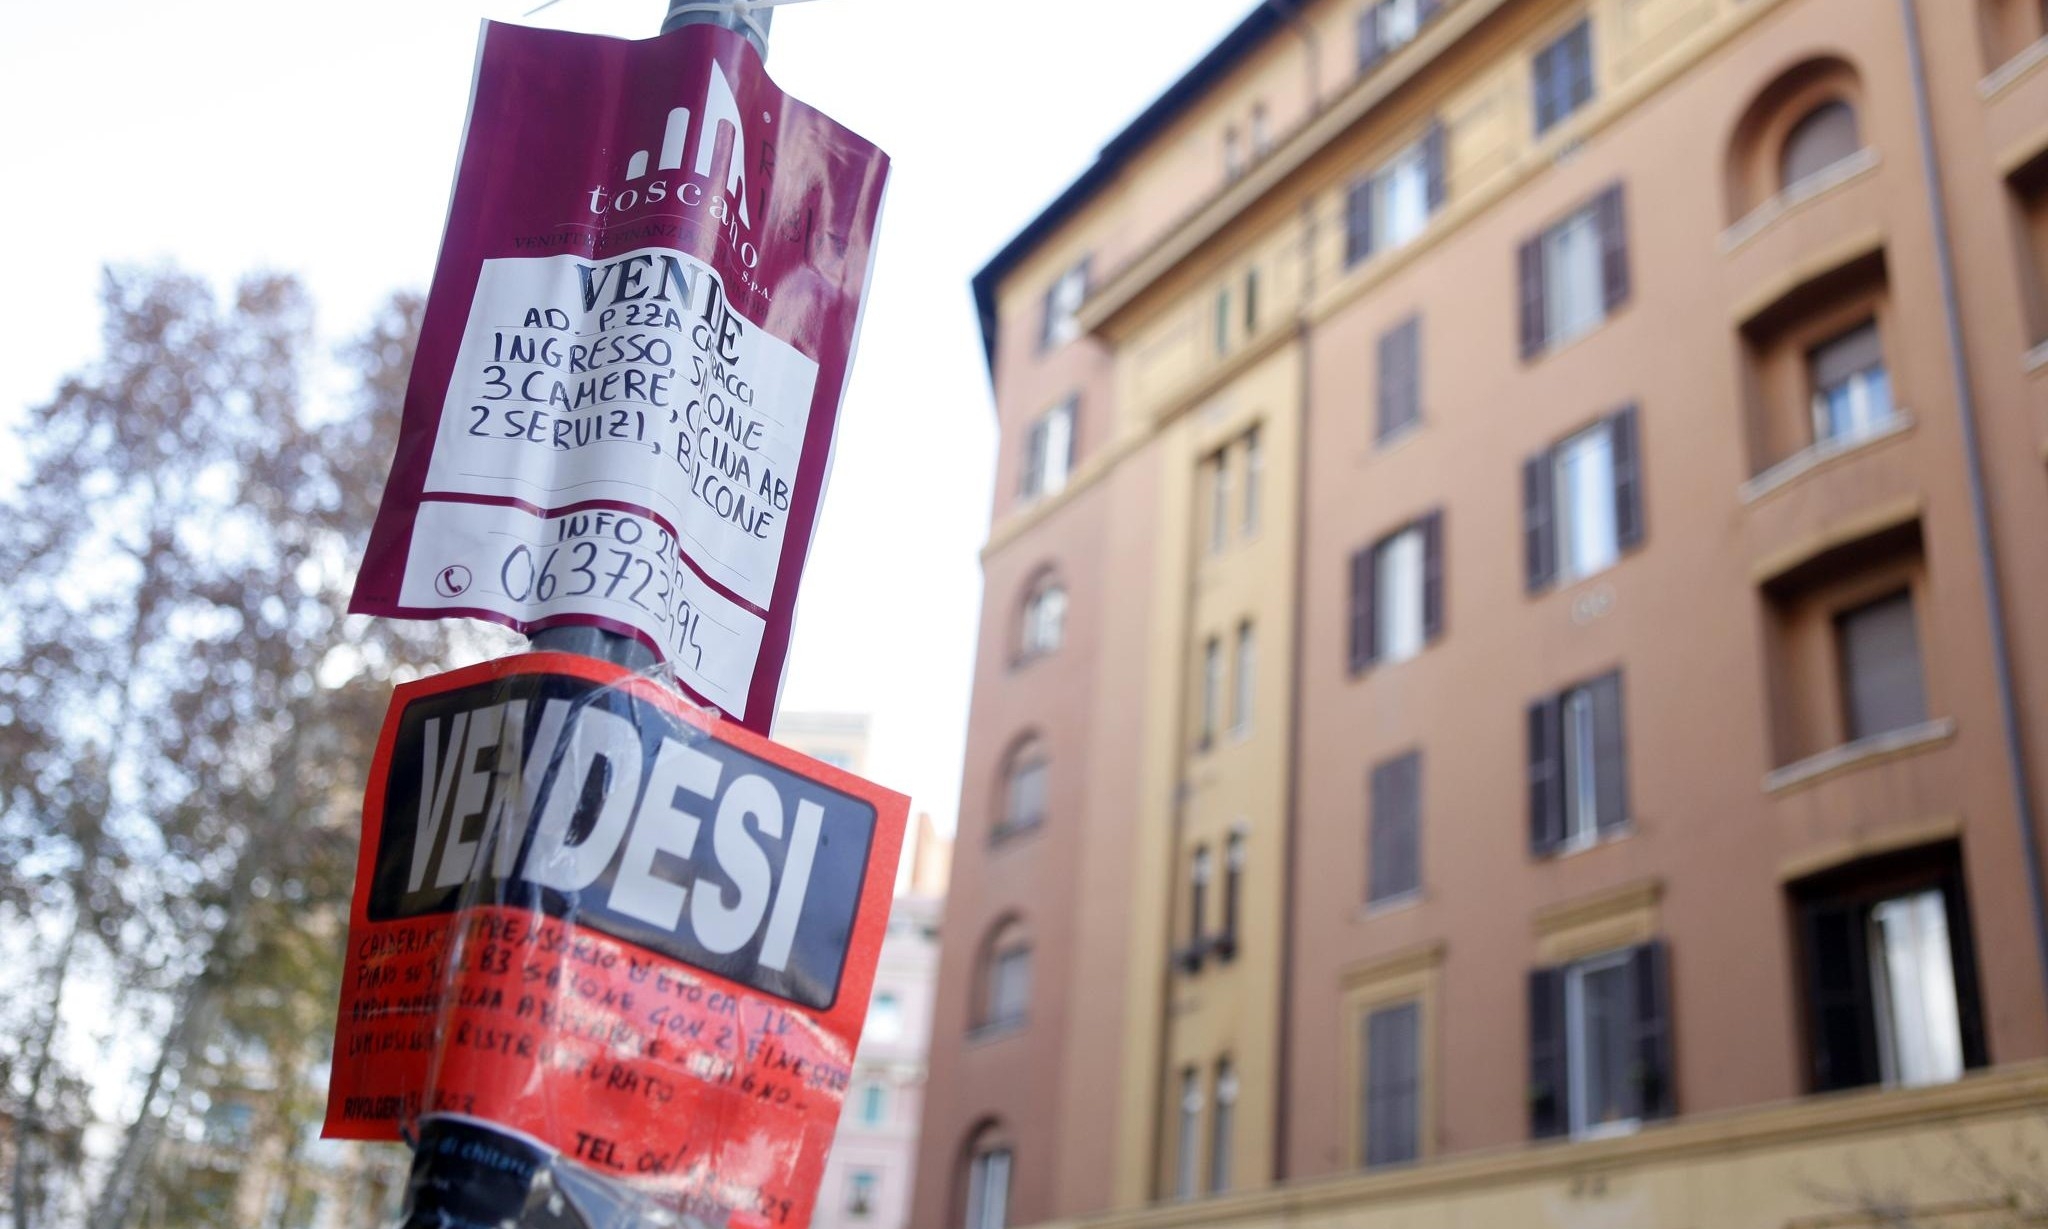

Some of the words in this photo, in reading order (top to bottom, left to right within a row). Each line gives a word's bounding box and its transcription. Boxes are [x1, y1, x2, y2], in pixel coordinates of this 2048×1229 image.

[588, 178, 757, 268] toscano
[574, 254, 743, 366] VENDE
[600, 304, 682, 332] P.ZZA
[469, 406, 490, 436] 2
[677, 432, 773, 538] BLCONE
[483, 366, 512, 400] 3
[686, 400, 750, 487] CCINA
[759, 468, 788, 511] AB
[559, 514, 642, 545] INFO
[408, 699, 824, 973] VENDESI
